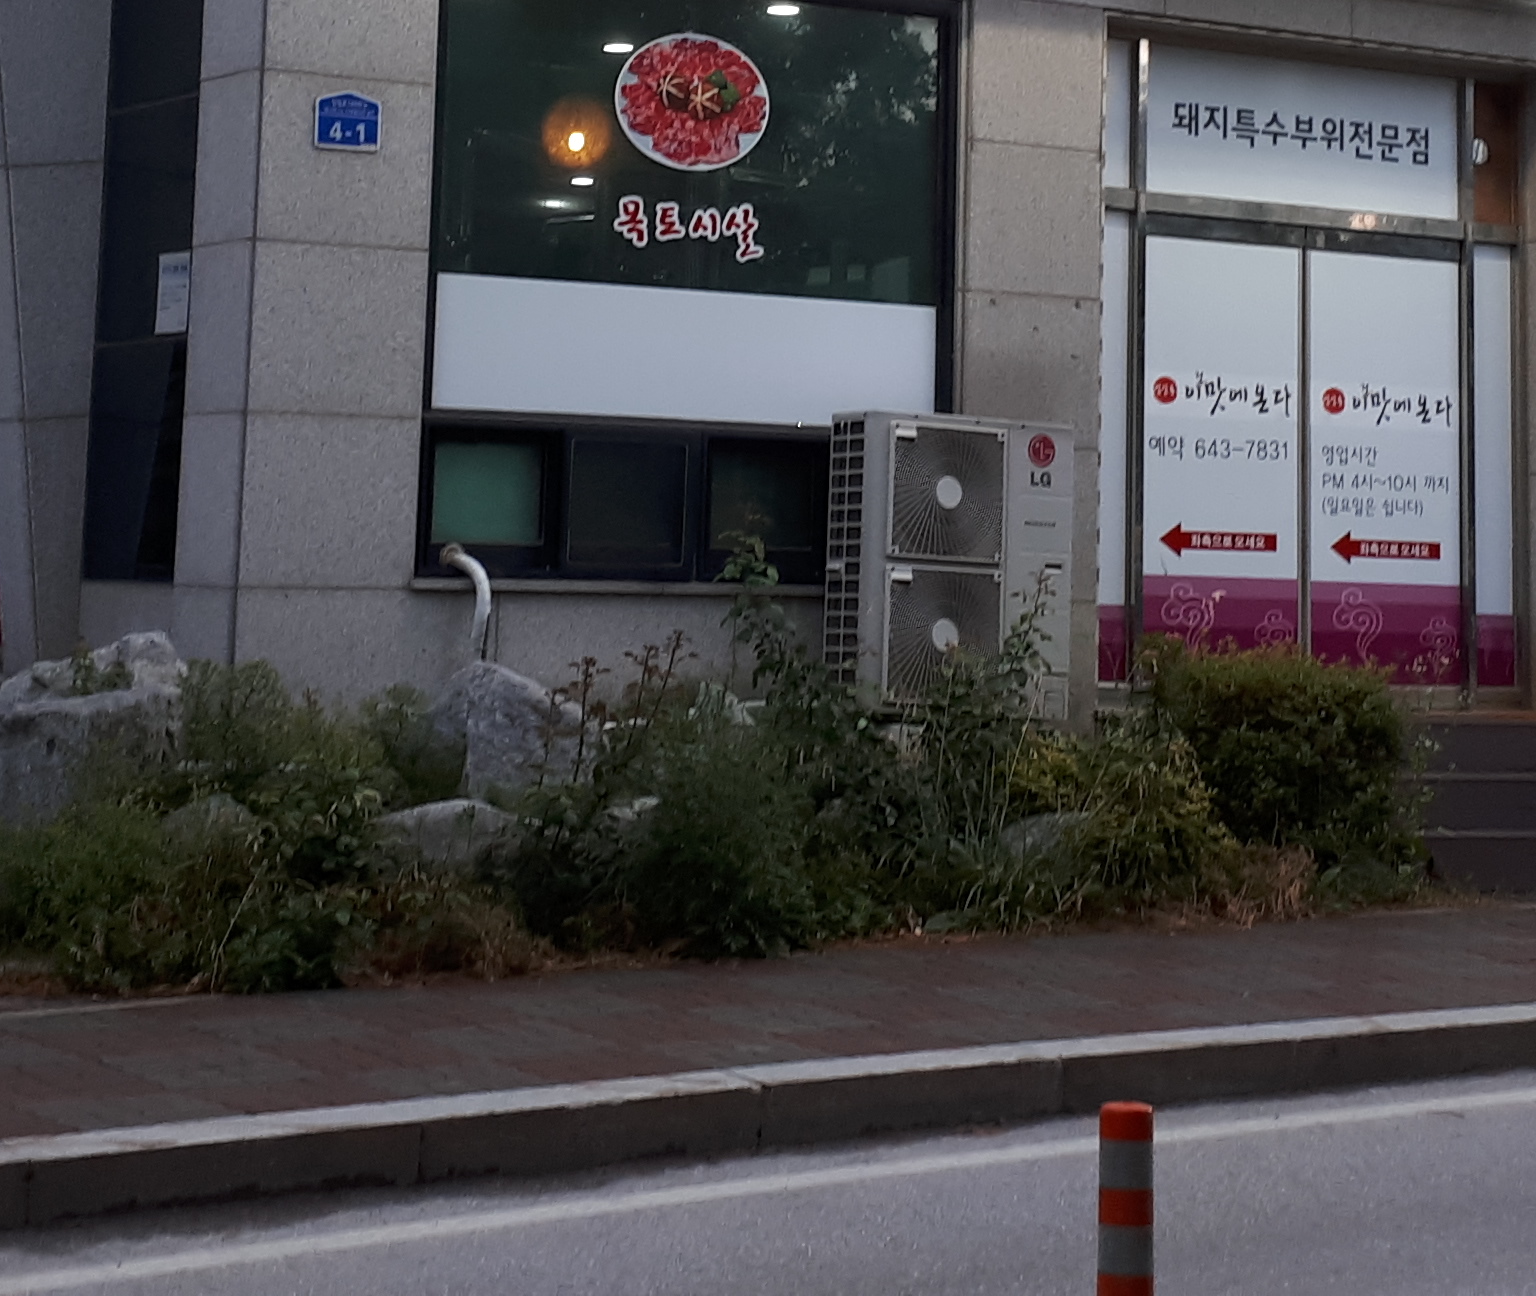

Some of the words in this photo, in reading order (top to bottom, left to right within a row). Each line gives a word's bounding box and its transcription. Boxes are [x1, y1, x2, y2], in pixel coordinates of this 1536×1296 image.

[329, 120, 366, 143] 4-1
[1171, 101, 1431, 166] 돼지특수부위전문점
[614, 194, 765, 264] 목토시살
[1148, 435, 1184, 462] 예약
[1194, 437, 1289, 461] 643-7831
[1321, 444, 1378, 468] 영업시간
[1030, 471, 1052, 489] LG
[1322, 473, 1345, 490] PM
[1423, 475, 1450, 495] 까지
